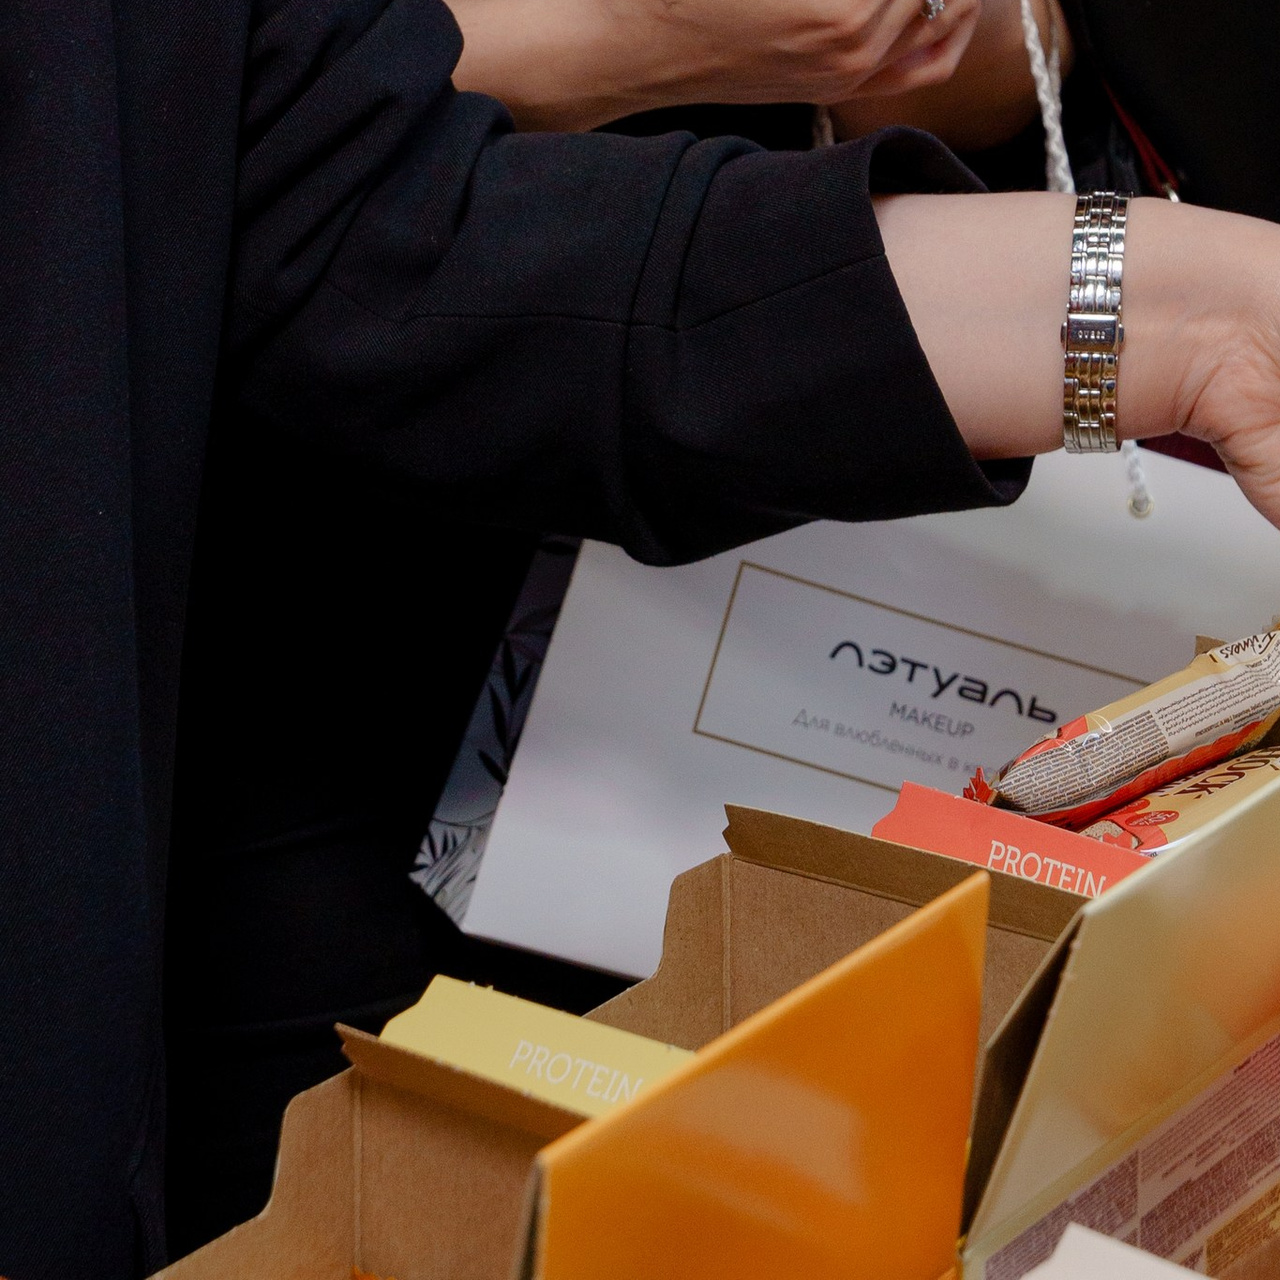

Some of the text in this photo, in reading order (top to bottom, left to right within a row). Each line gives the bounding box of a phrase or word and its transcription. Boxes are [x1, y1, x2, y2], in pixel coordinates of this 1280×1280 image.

[791, 707, 831, 732] Для
[889, 701, 976, 740] MAKEUP
[986, 840, 1107, 899] PROTEIN
[508, 1039, 644, 1104] PROTEIN
